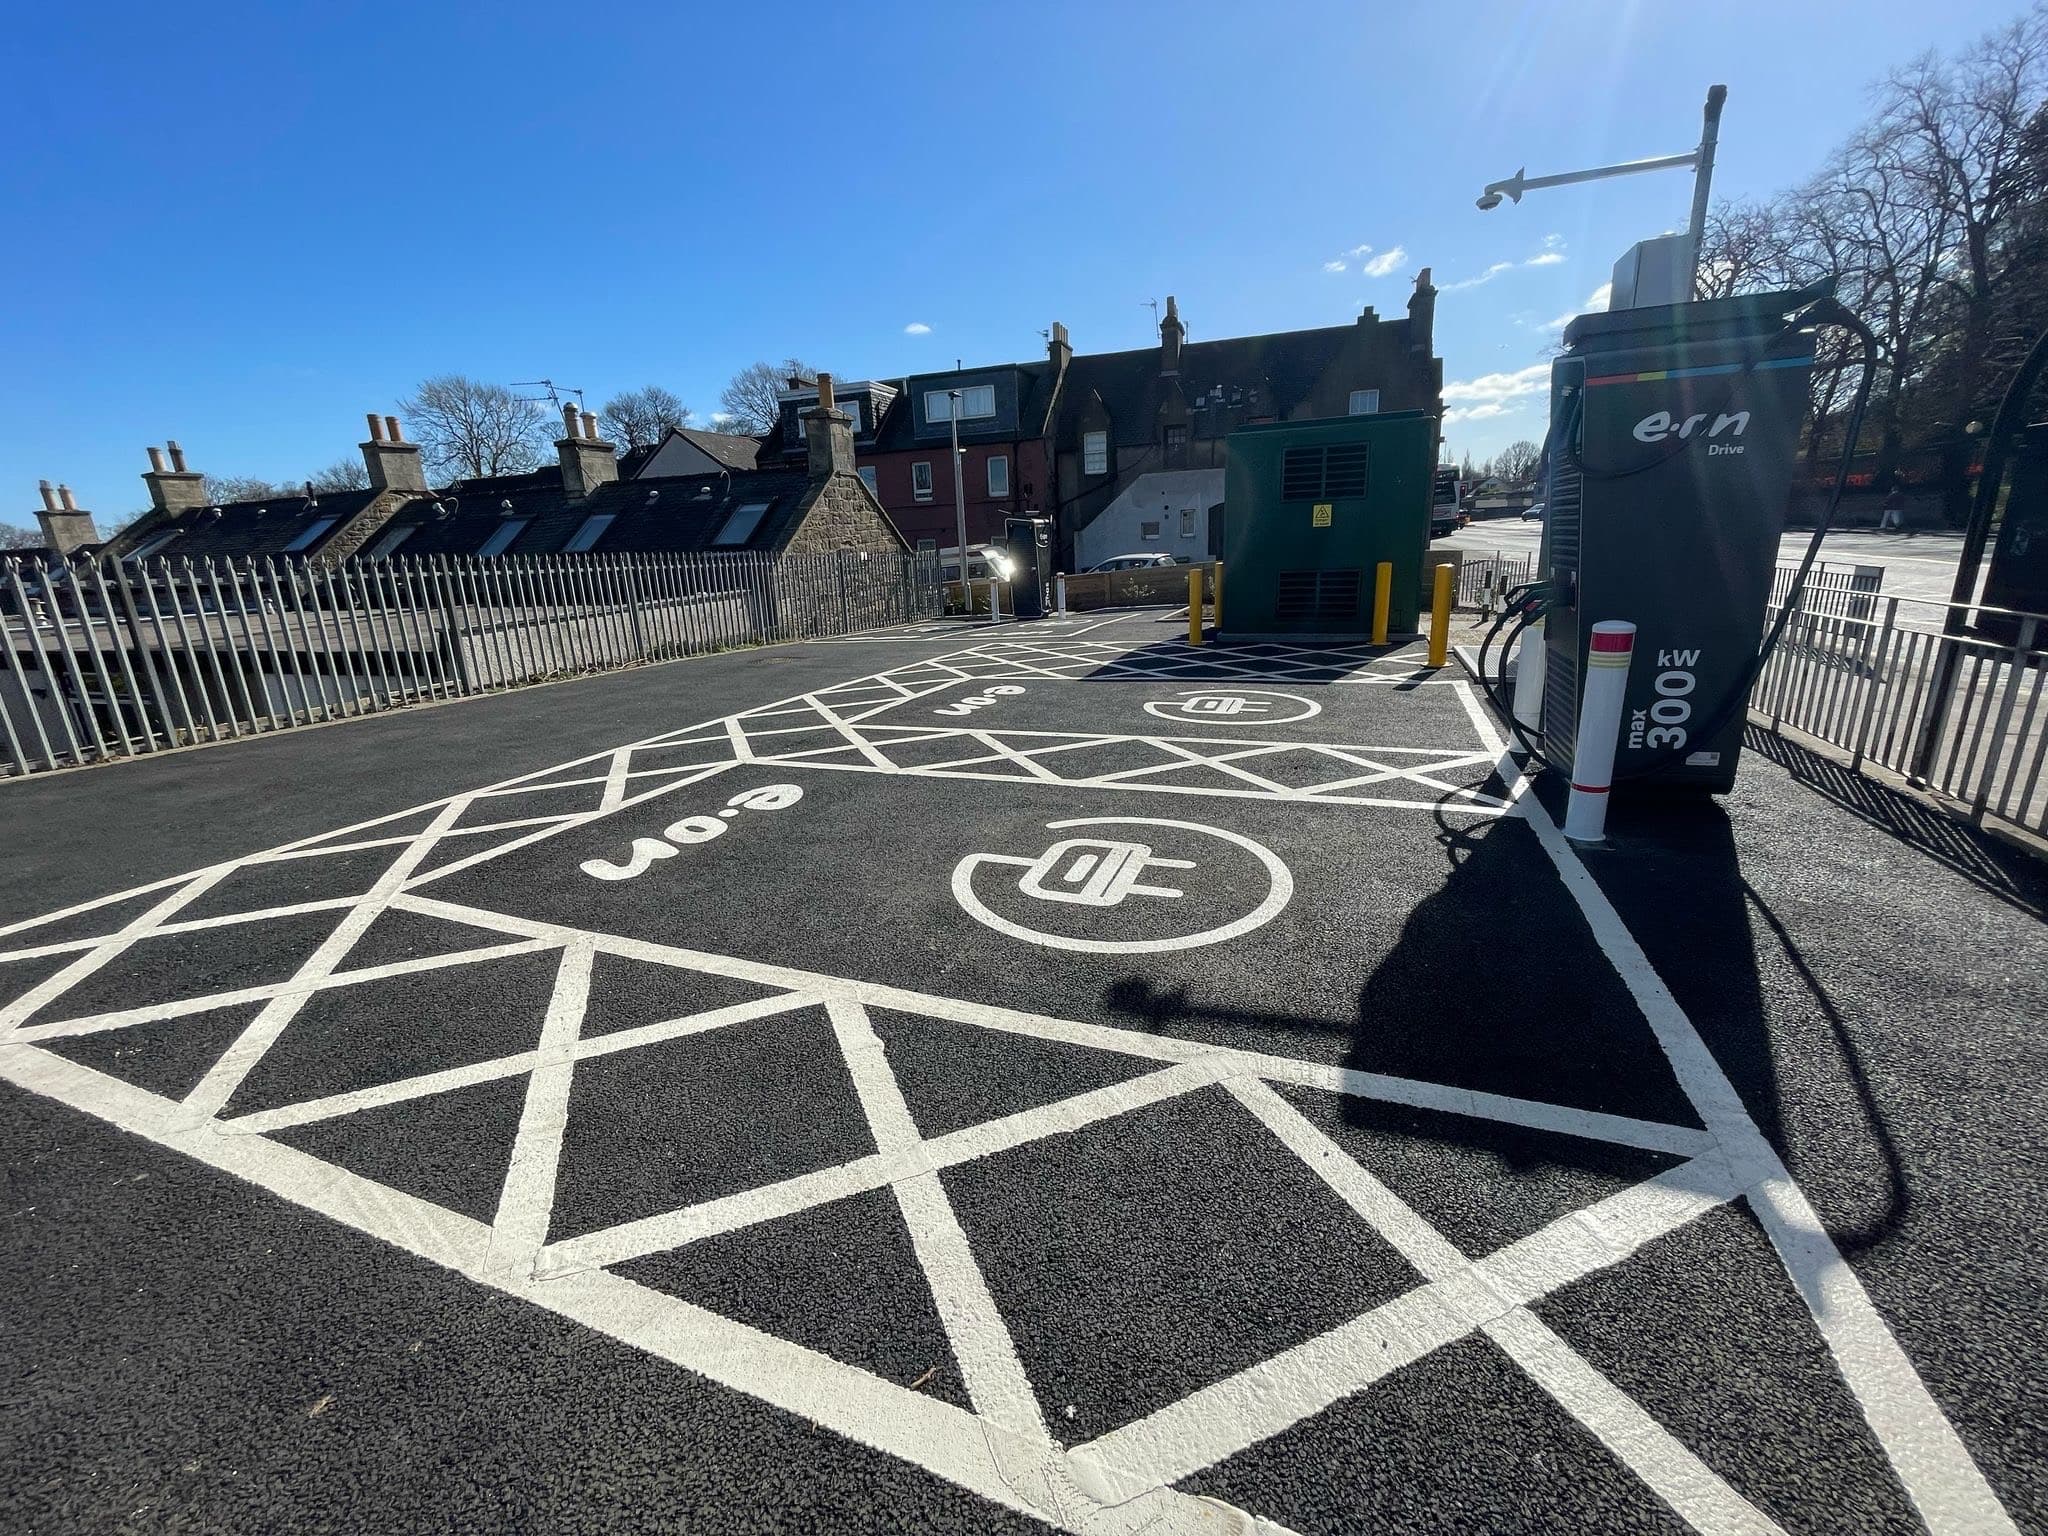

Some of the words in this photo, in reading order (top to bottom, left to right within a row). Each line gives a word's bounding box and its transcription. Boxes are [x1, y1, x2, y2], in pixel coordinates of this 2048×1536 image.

[1708, 443, 1745, 456] Drive
[1657, 649, 1701, 667] kW
[1646, 670, 1696, 749] 300
[1628, 708, 1647, 749] max
